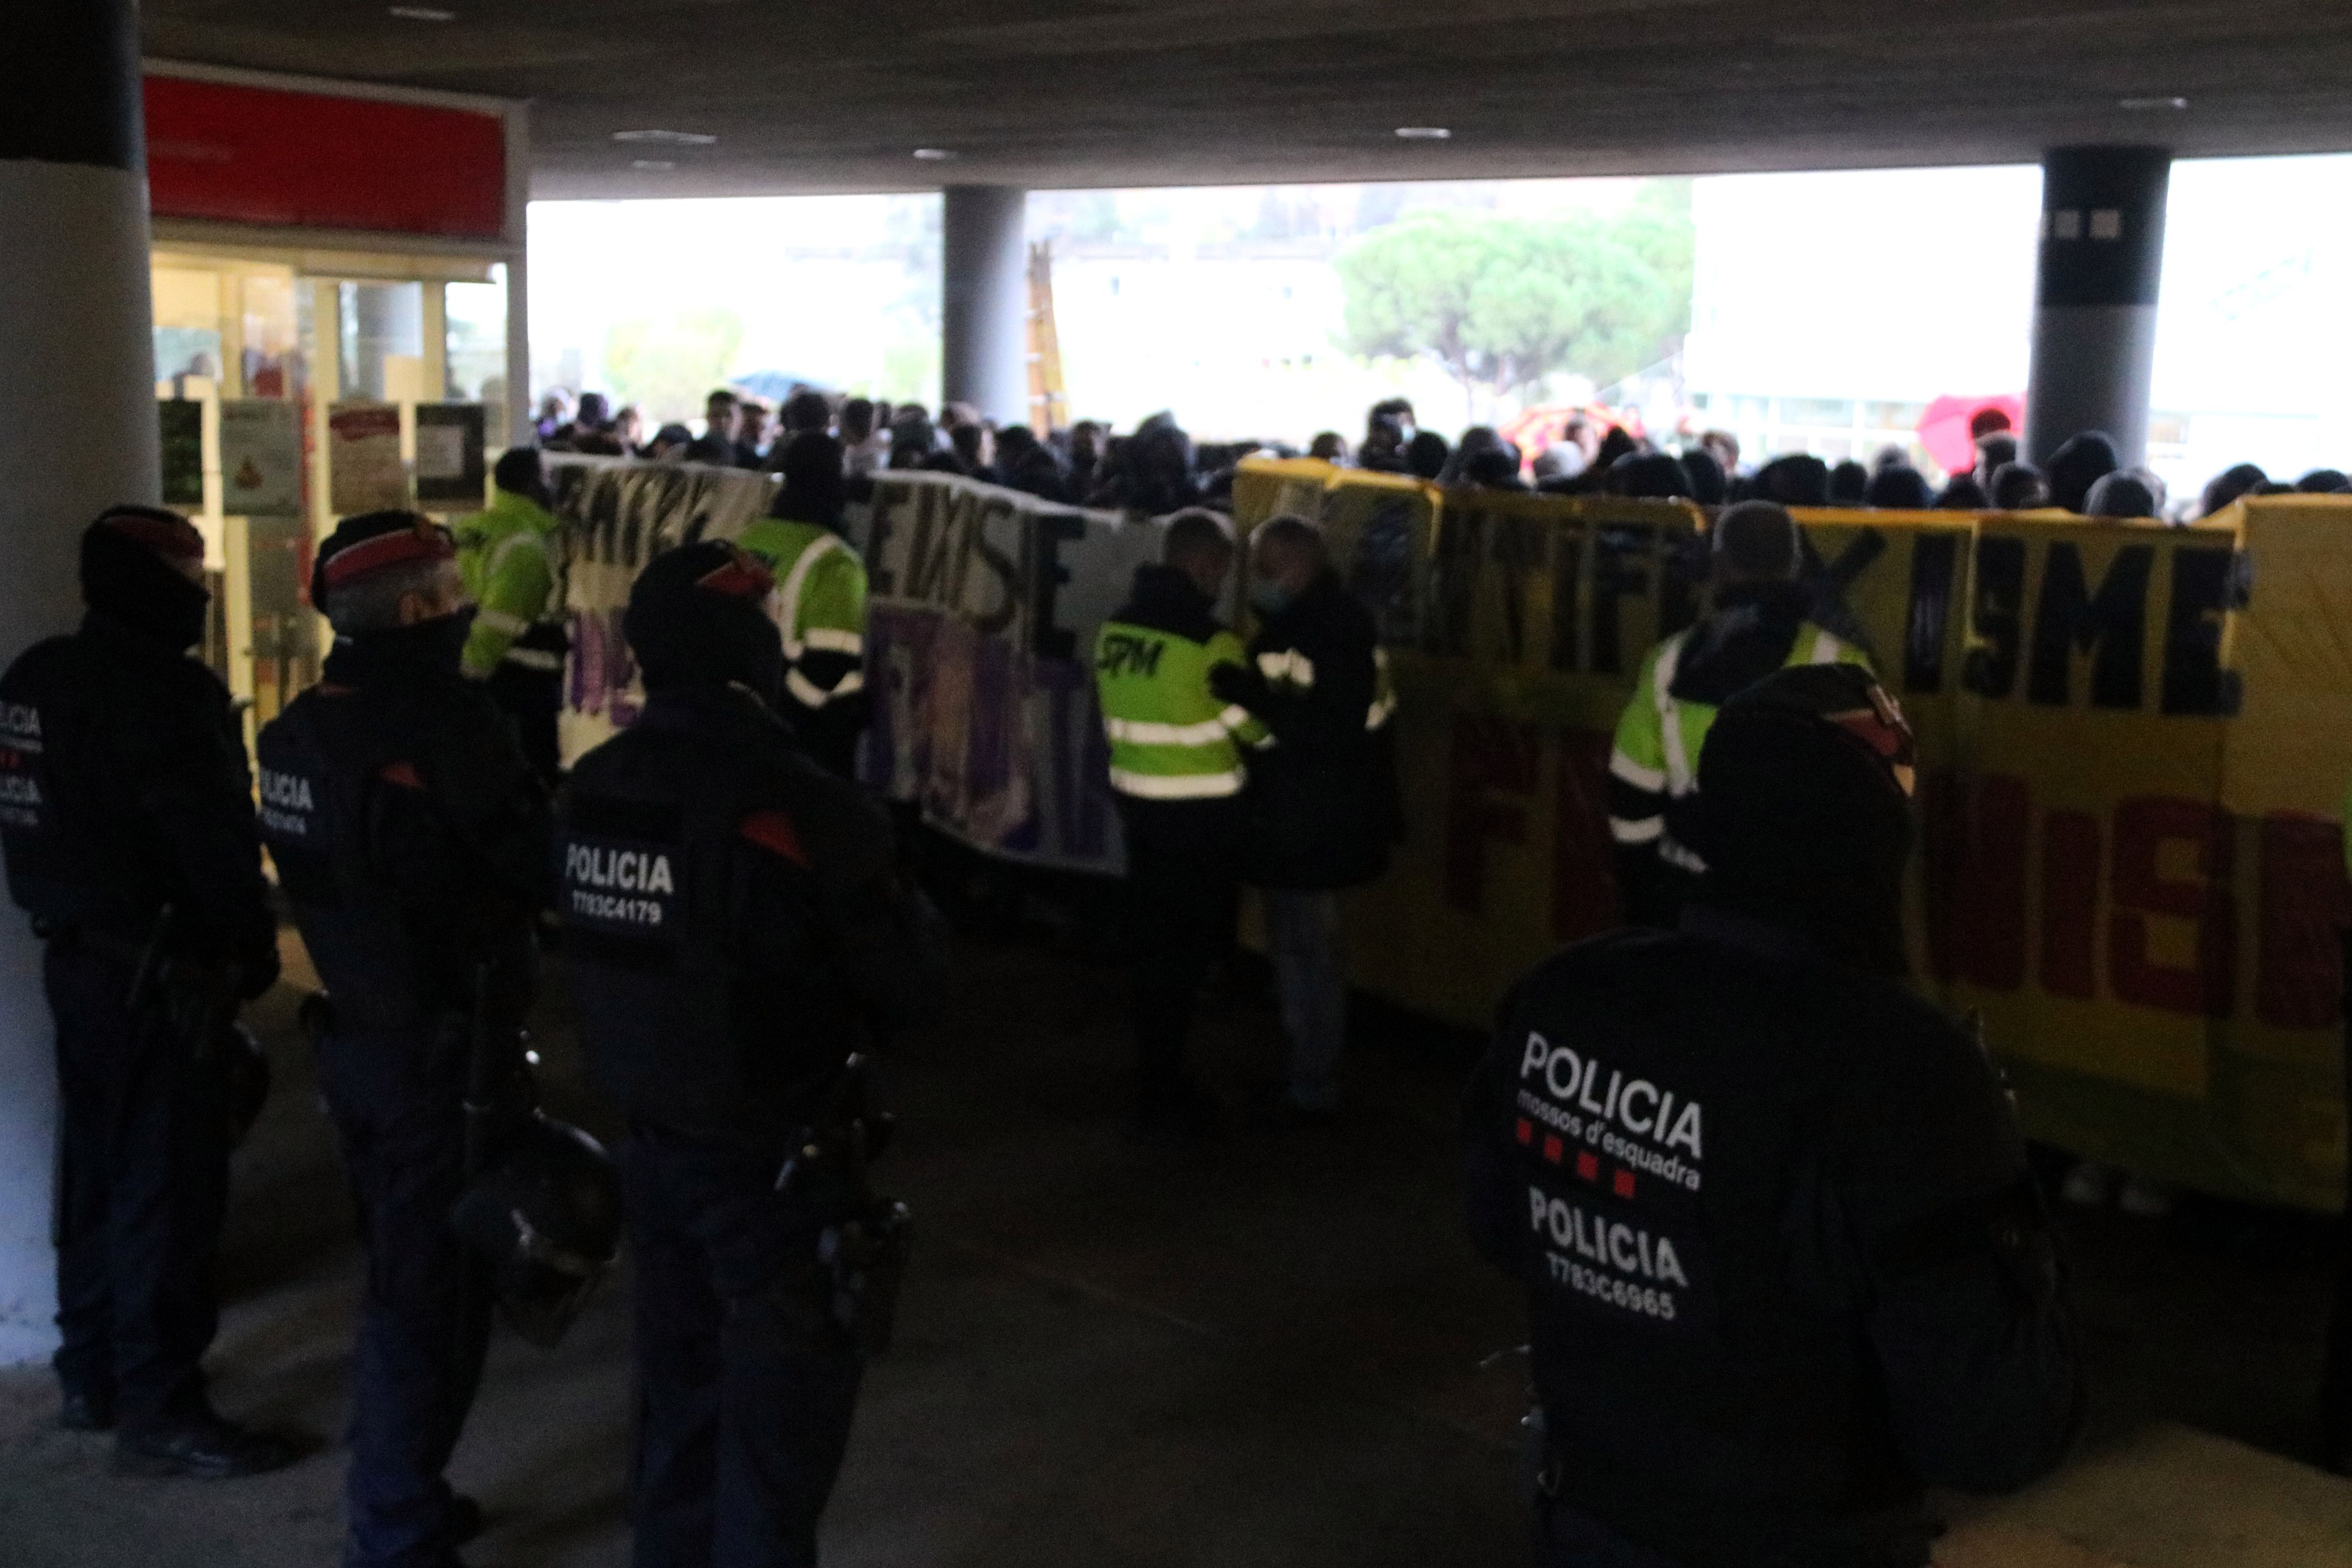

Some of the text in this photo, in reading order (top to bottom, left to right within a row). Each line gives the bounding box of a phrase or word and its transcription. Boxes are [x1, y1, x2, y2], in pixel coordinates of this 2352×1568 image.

[1099, 633, 1166, 678] SPM
[565, 842, 674, 895] POLICIA
[1517, 1088, 1701, 1192] mossos d'esquadra
[1520, 1030, 1703, 1160] POLICIA
[1528, 1186, 1689, 1287] POLICIA
